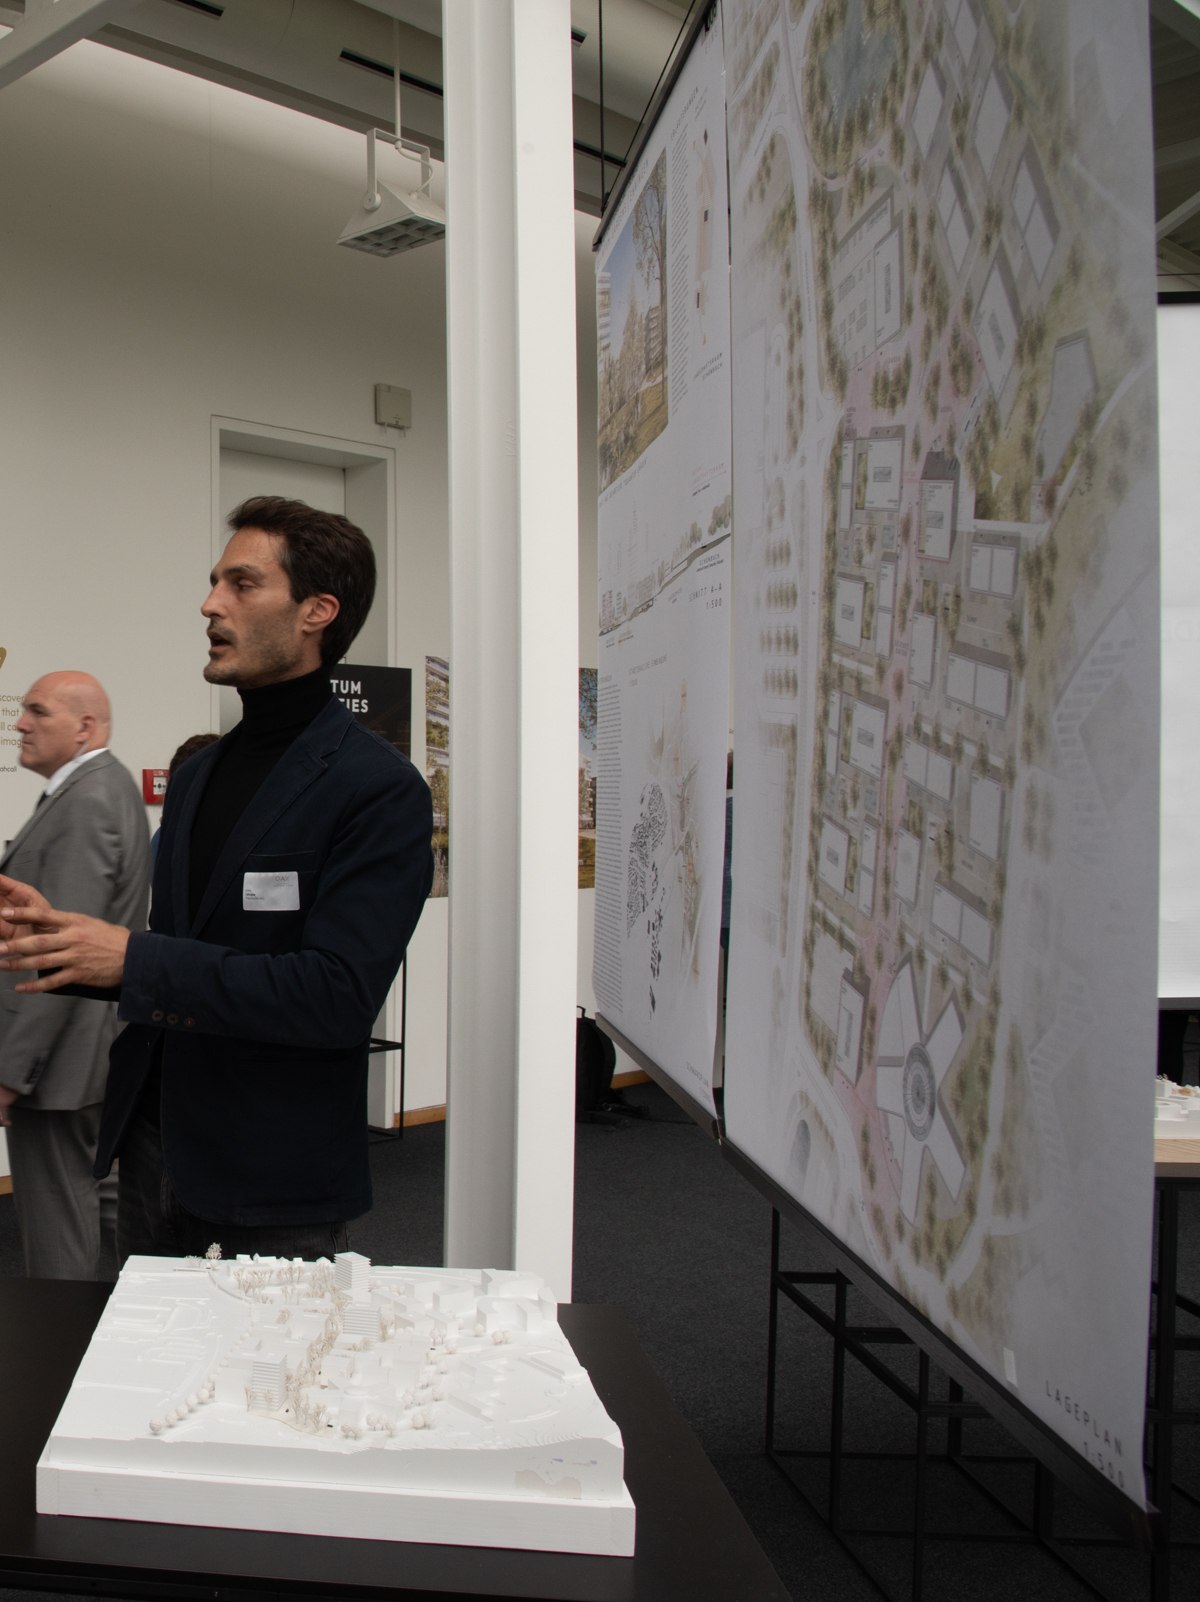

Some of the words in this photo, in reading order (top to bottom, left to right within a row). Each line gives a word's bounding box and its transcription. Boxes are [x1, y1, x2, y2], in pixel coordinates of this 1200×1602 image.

[330, 679, 361, 695] TUM
[1, 707, 20, 717] that
[1045, 1379, 1123, 1457] LAGEPLAN
[1082, 1441, 1126, 1489] 1:500
